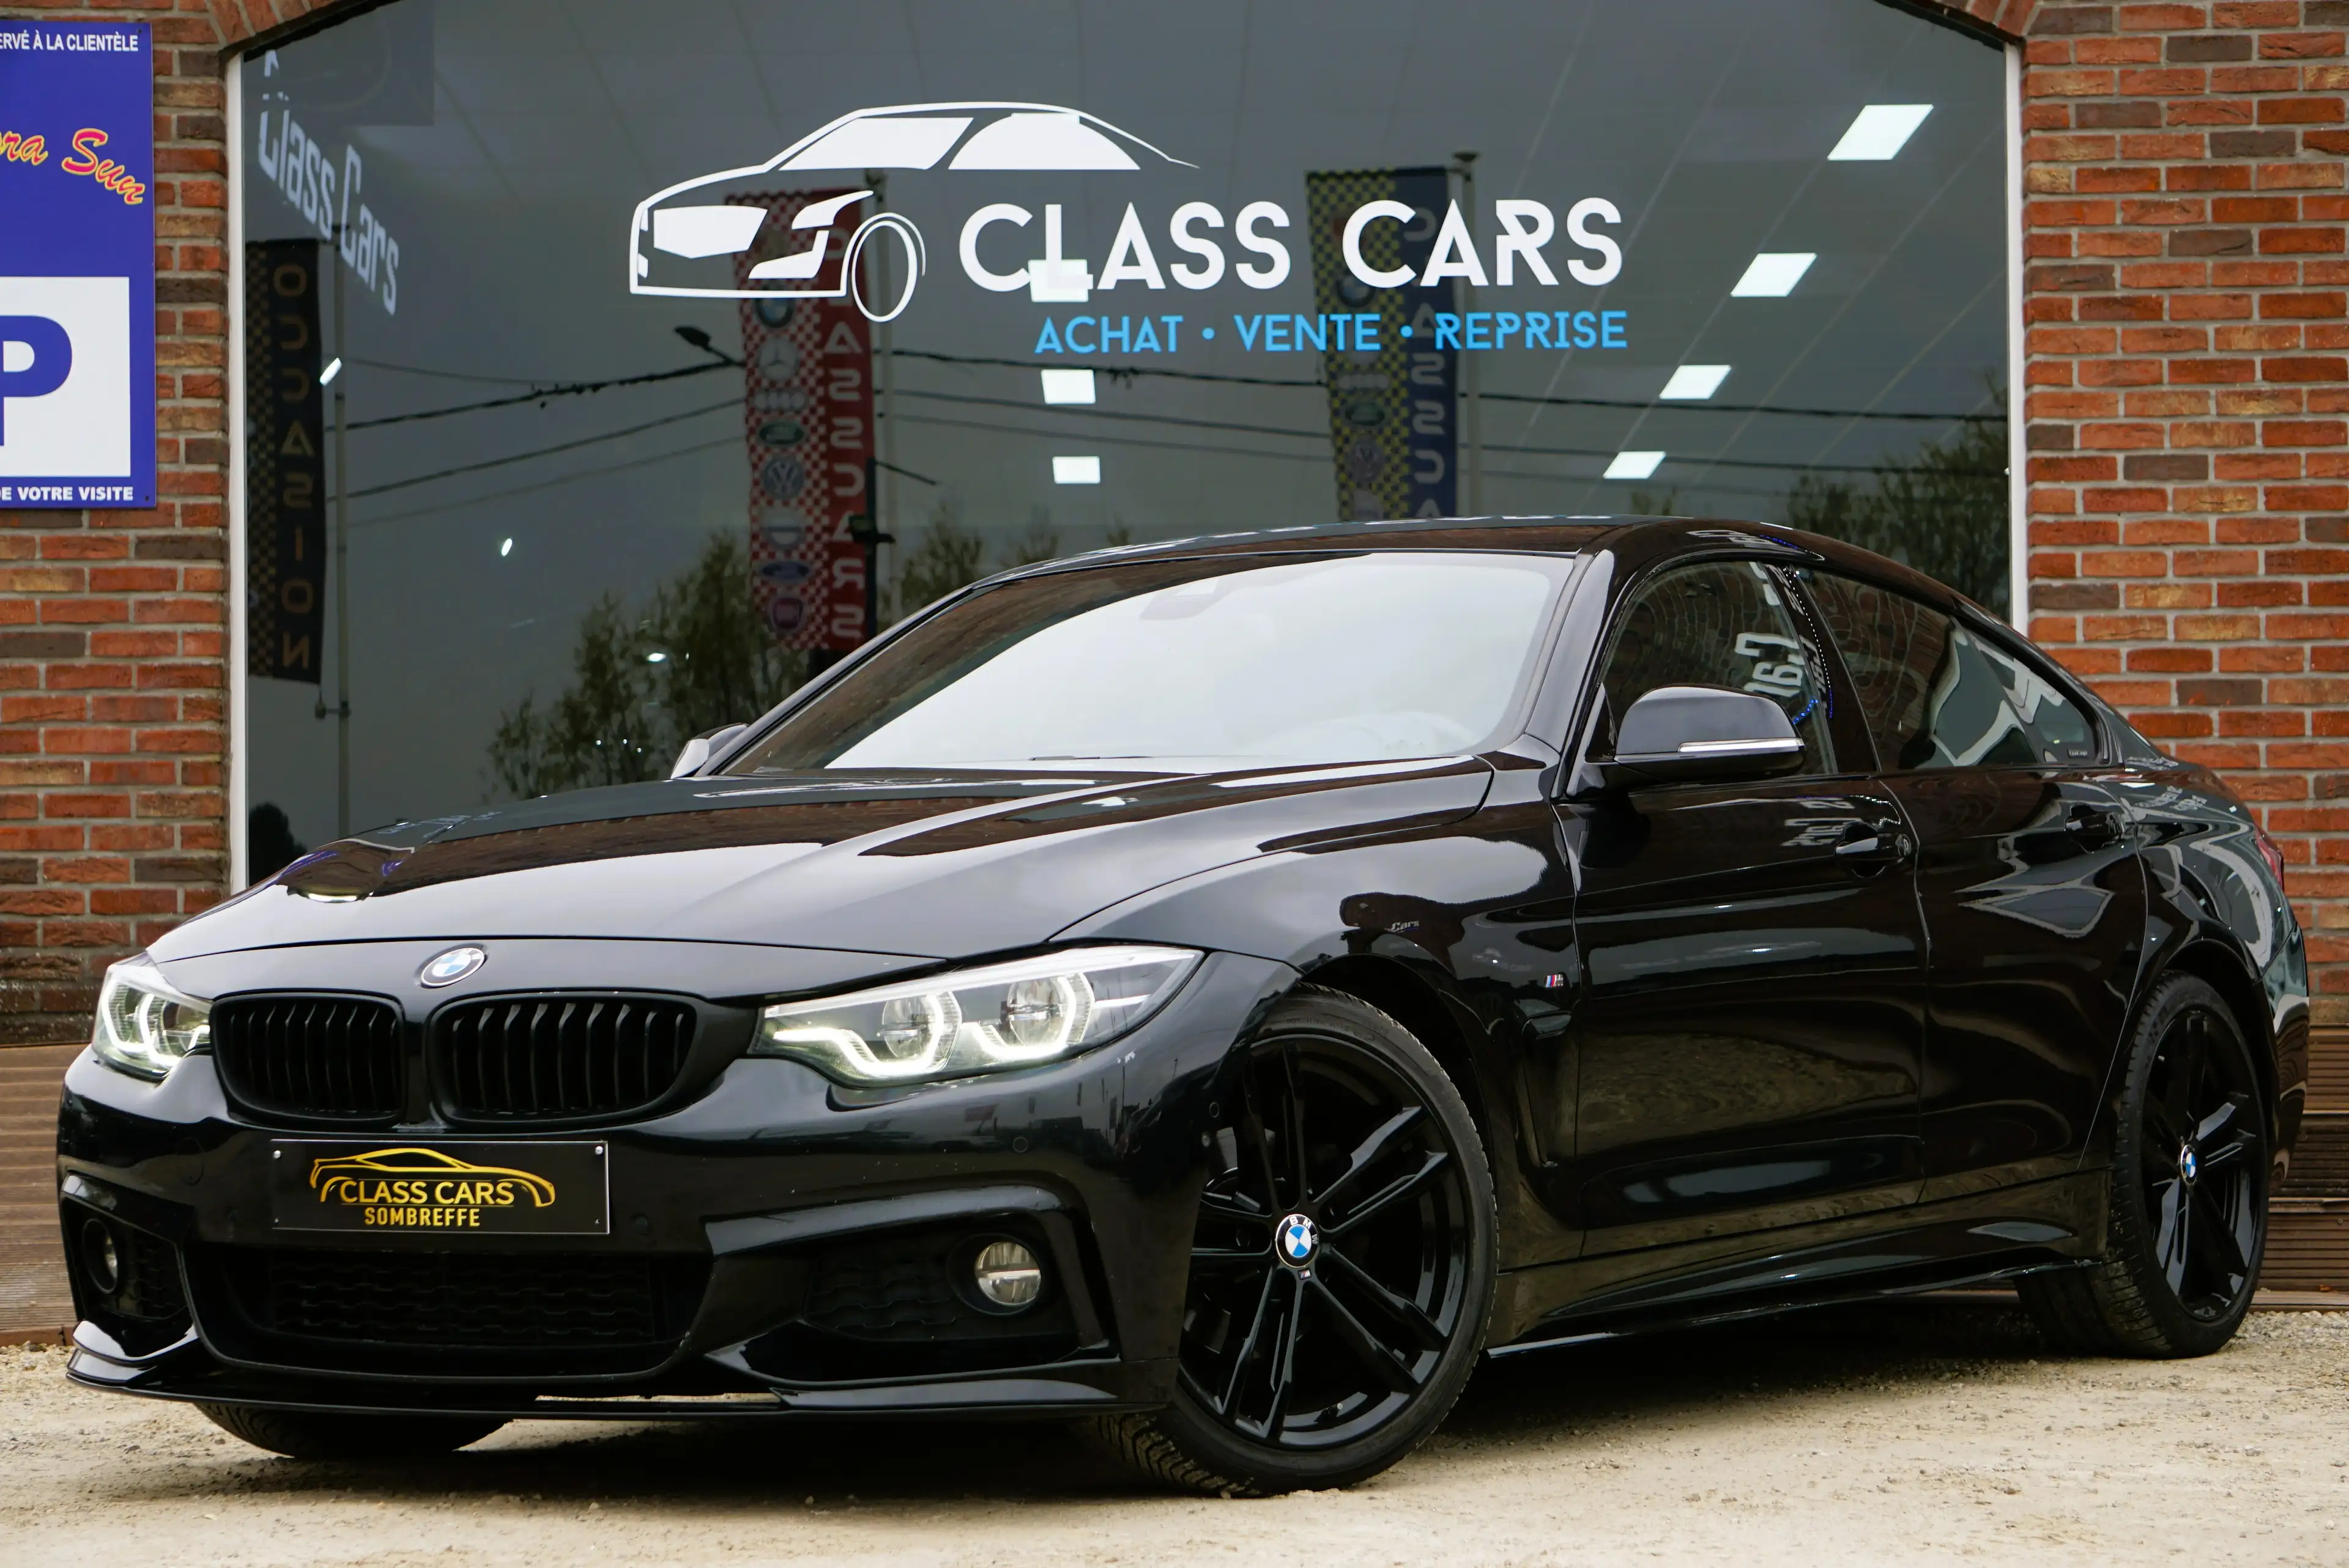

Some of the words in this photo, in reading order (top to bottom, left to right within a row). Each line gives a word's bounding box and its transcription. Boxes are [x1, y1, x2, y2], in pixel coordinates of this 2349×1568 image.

[33, 29, 43, 50] À
[46, 34, 64, 51] LA
[67, 31, 138, 51] CLIENTÈLE
[61, 128, 146, 205] Sun
[340, 143, 399, 316] Cars
[959, 201, 1291, 292] CLASS
[1342, 198, 1623, 289] CARS
[1034, 315, 1184, 353] ACHAT
[1233, 314, 1381, 352] VENTE
[1434, 311, 1628, 350] REPRISE
[0, 315, 72, 446] P
[0, 487, 12, 500] E
[17, 487, 73, 500] VOTRE
[79, 487, 133, 500] VISITE
[340, 1180, 428, 1205] CLASS
[435, 1180, 515, 1205] CARS
[364, 1207, 480, 1227] SOMBREFFE
[1289, 1216, 1319, 1244] BMW
